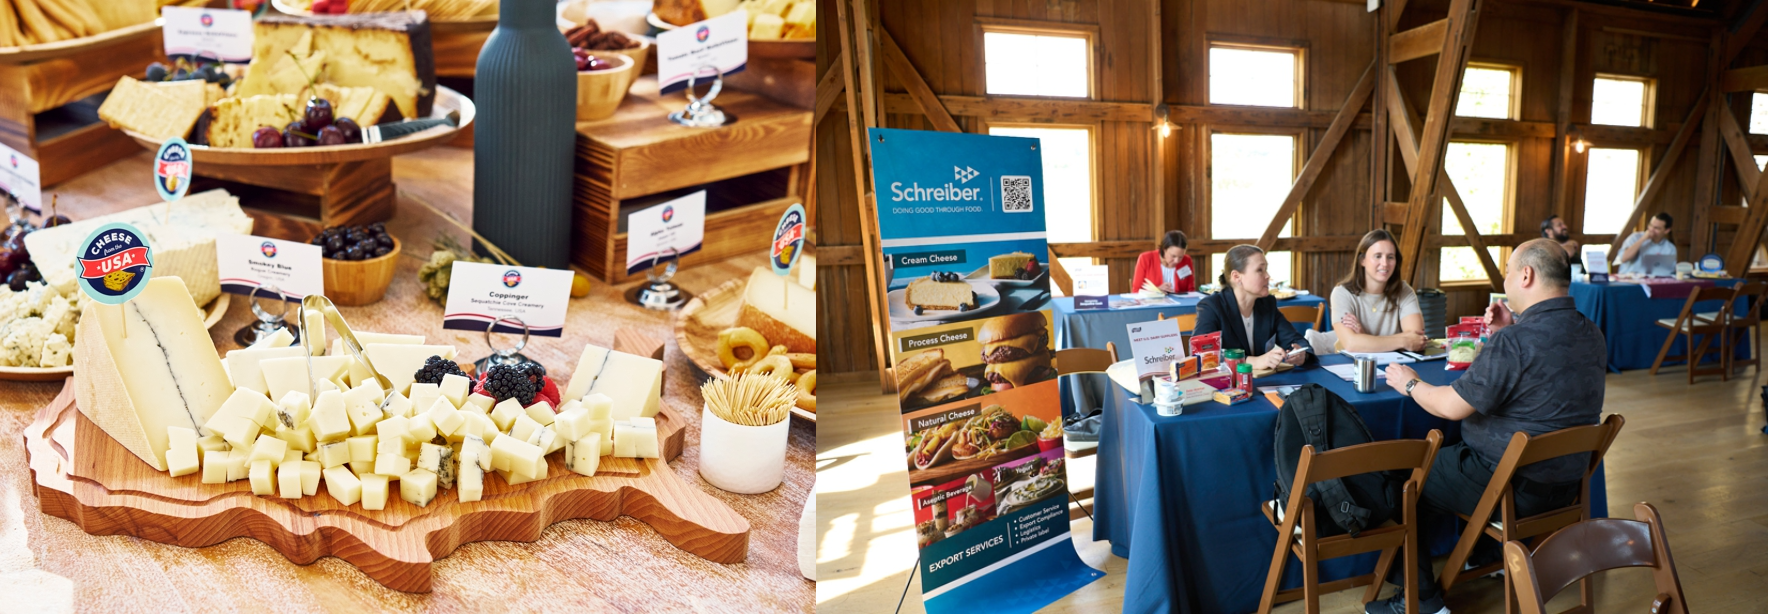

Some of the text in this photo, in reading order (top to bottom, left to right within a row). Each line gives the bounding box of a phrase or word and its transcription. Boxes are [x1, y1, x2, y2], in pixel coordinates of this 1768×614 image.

[91, 232, 133, 256] CHEESE
[104, 247, 115, 256] from
[101, 252, 132, 273] USA
[248, 259, 292, 271] Smokey Blue
[901, 253, 958, 265] Cream Cheese
[489, 291, 529, 300] Coppinger
[908, 332, 968, 348] Process Cheese
[1144, 354, 1175, 365] Schreiber
[918, 408, 975, 428] Natural Cheese
[1015, 464, 1034, 474] Yogurt
[922, 484, 973, 506] Aseptic Beverage
[1019, 504, 1060, 522] Customer Service
[1019, 509, 1063, 530] Export Compliance
[1020, 525, 1041, 537] Logistics
[929, 534, 1004, 573] EXPORT SERVICES
